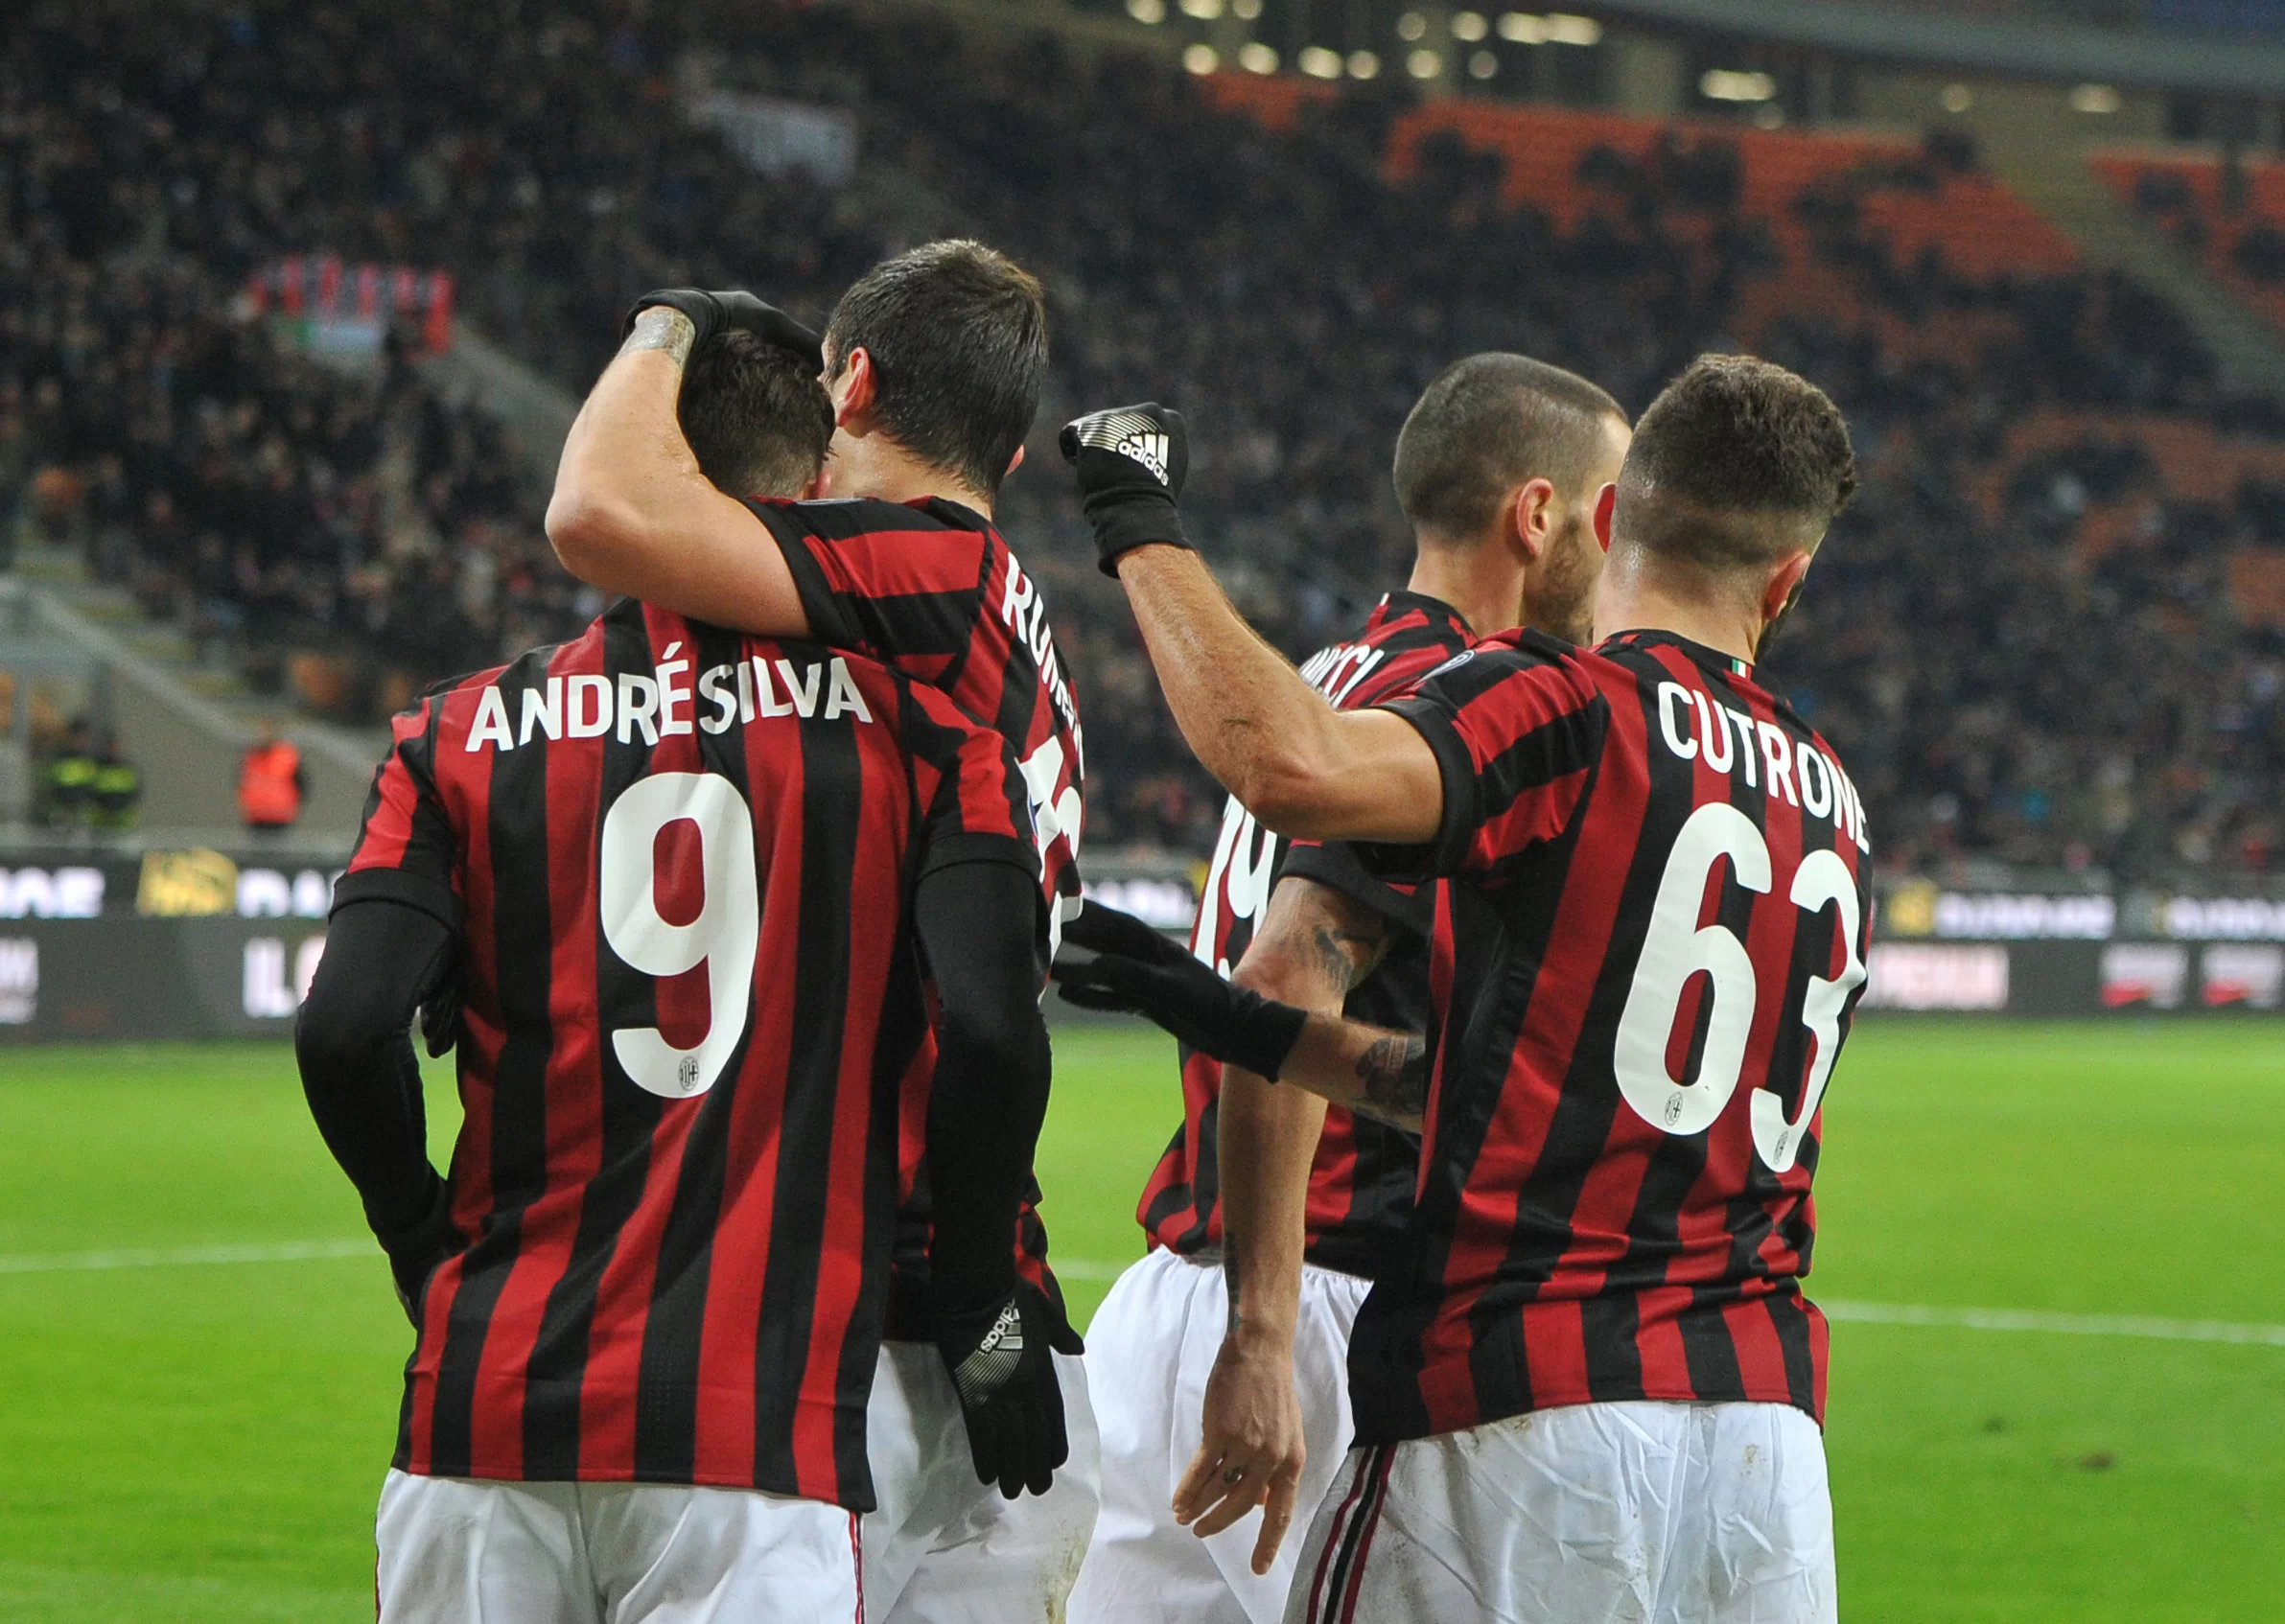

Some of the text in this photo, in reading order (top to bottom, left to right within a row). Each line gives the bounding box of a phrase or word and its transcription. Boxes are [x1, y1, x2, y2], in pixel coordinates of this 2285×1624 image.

[1118, 440, 1170, 487] adidas
[1657, 681, 1871, 856] CUTRONE
[600, 771, 759, 1099] 9
[1614, 801, 1868, 1173] 63
